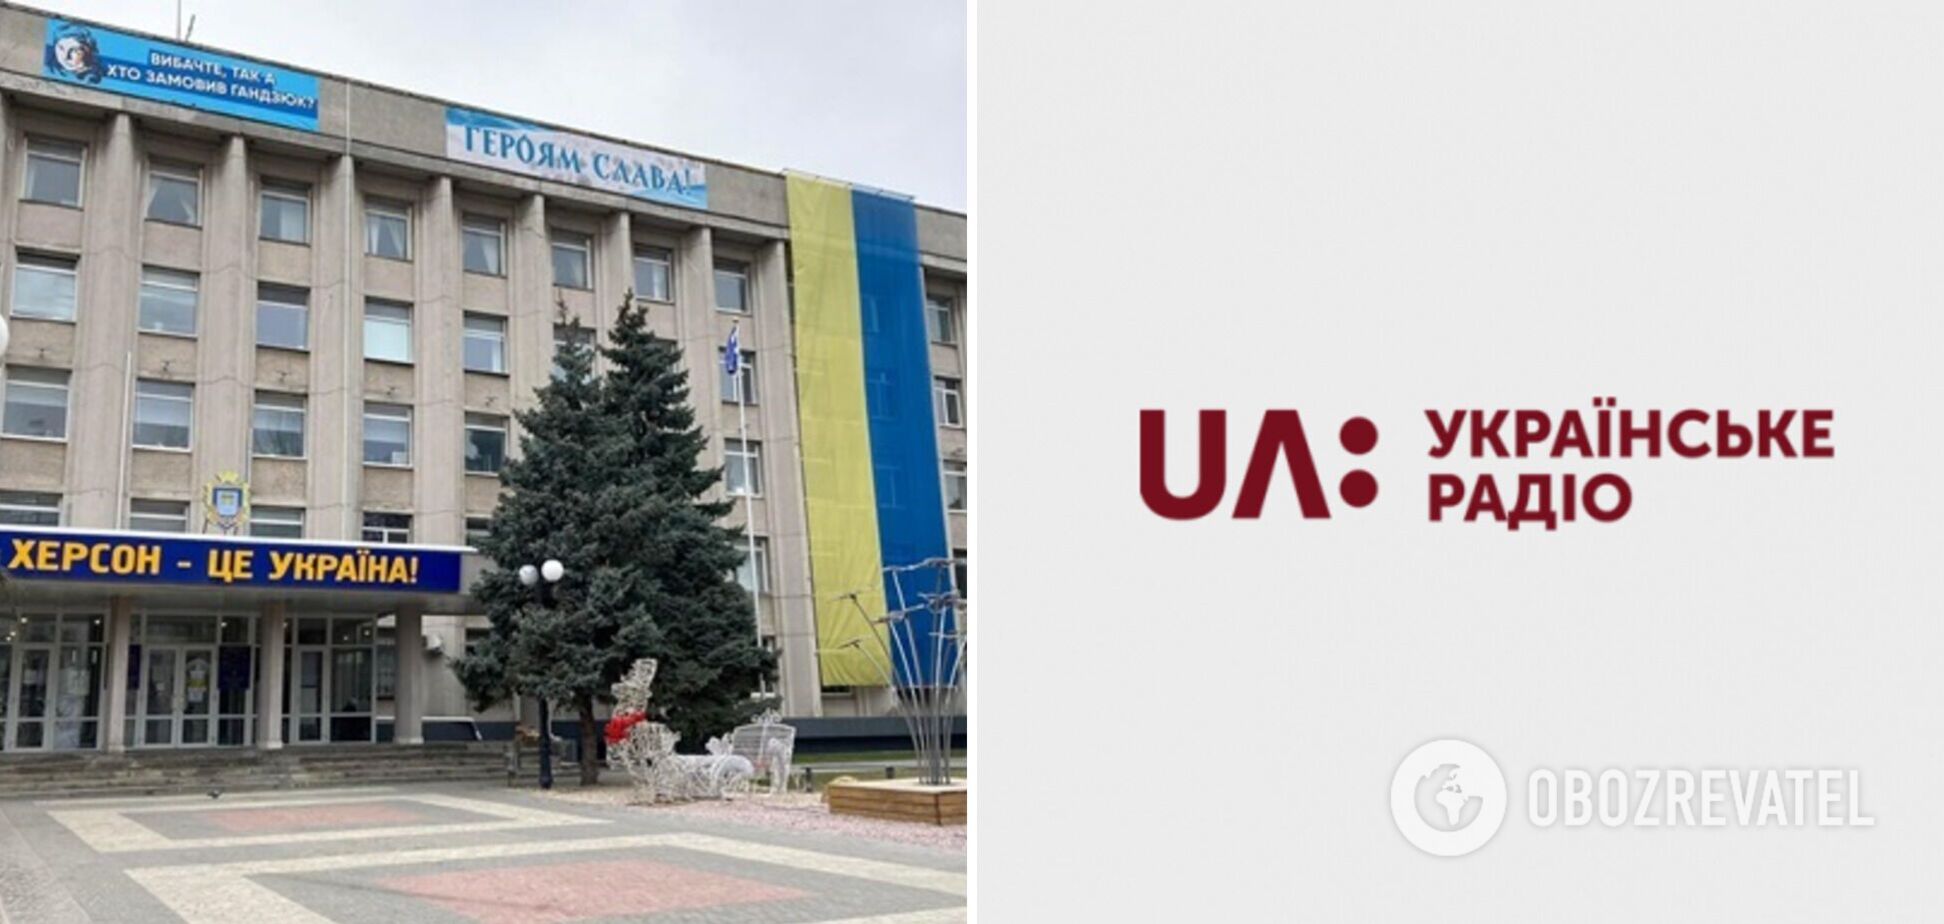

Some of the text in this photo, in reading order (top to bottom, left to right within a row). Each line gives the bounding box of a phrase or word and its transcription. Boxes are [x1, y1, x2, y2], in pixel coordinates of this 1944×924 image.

[106, 63, 314, 109] ХТО ЗАМОВИВ ГАНДЗЮК?
[150, 52, 276, 85] ВИБАЧТЕ, ТАК А
[464, 126, 694, 196] ГЕРОЯМ СЛАВА!
[1424, 397, 1835, 459] УКРАЇНСЬКЕ
[1428, 473, 1633, 531] РАДІО
[7, 538, 162, 575] ХЕРСОН
[207, 549, 254, 584] ЦЕ
[268, 549, 420, 584] УКРАЇНА!
